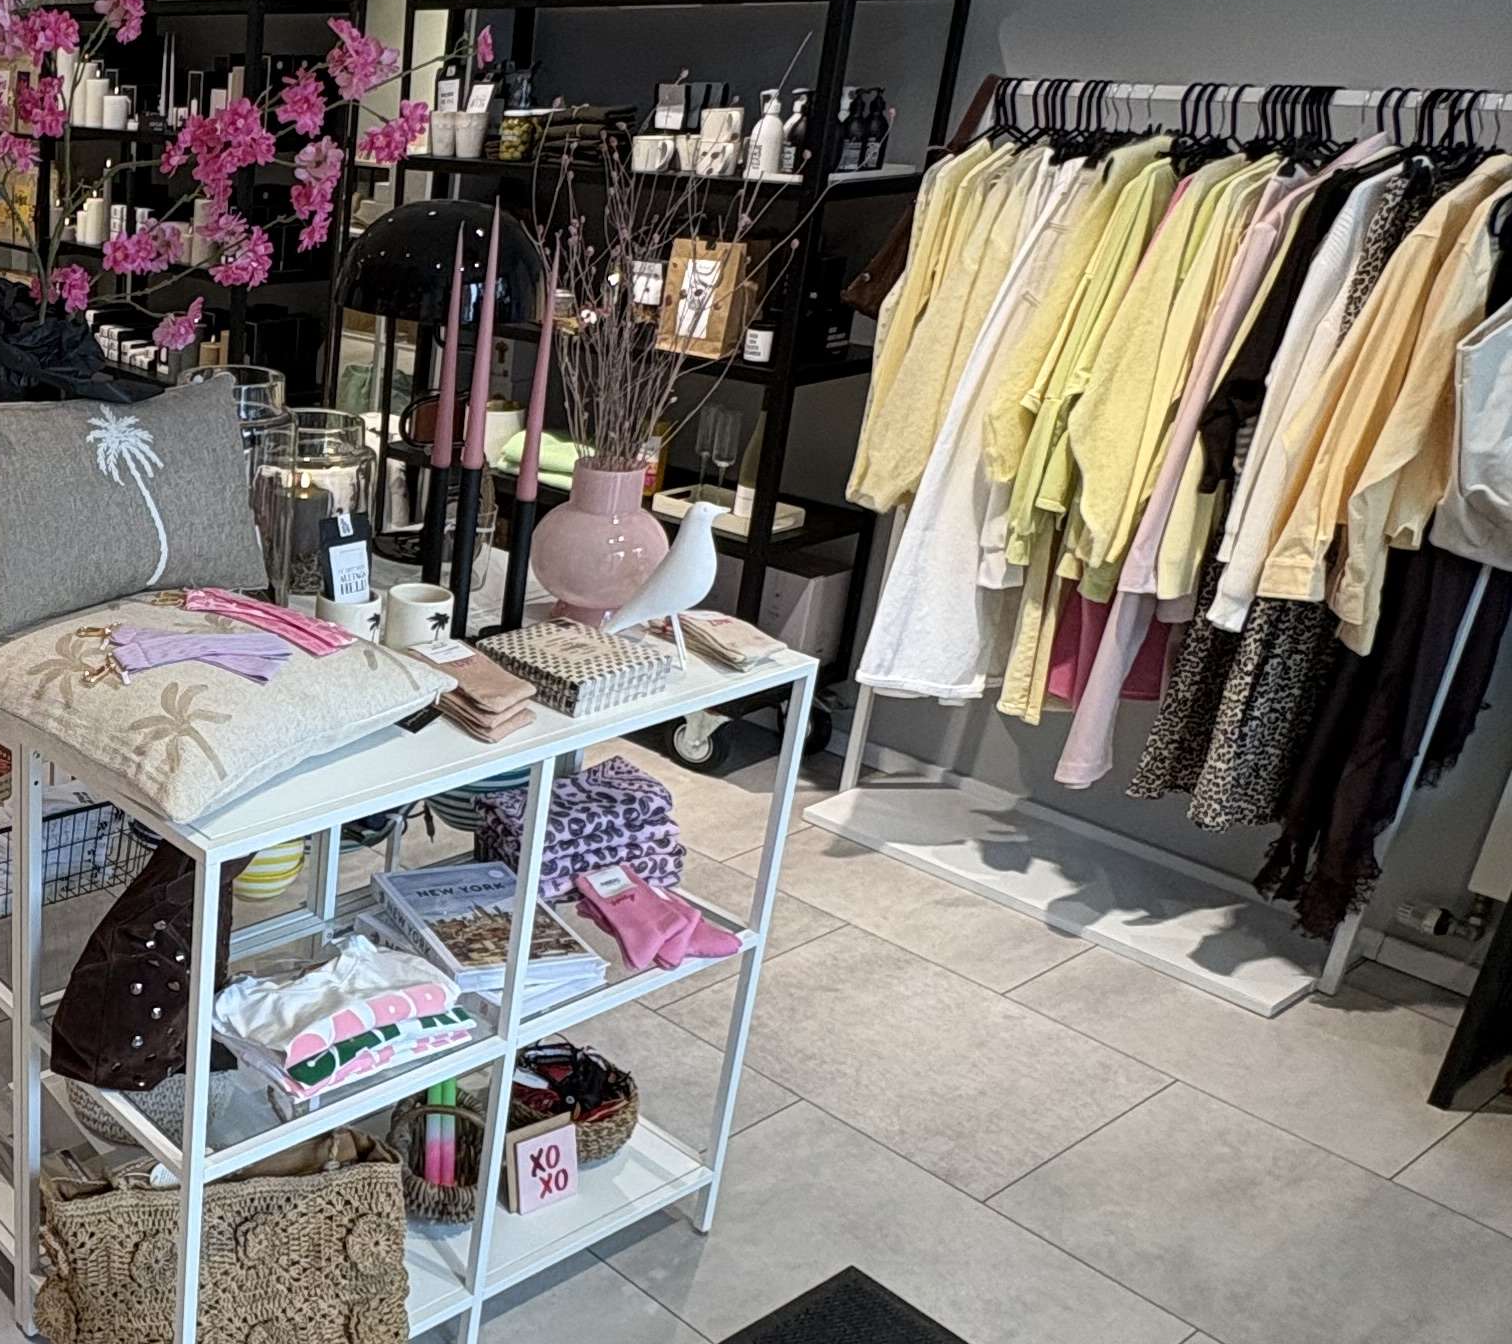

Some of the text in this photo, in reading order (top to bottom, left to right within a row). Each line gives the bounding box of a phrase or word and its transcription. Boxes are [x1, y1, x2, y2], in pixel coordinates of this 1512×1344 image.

[415, 881, 507, 898] NEW YORK
[529, 1144, 561, 1178] XO
[539, 1167, 569, 1199] XO
